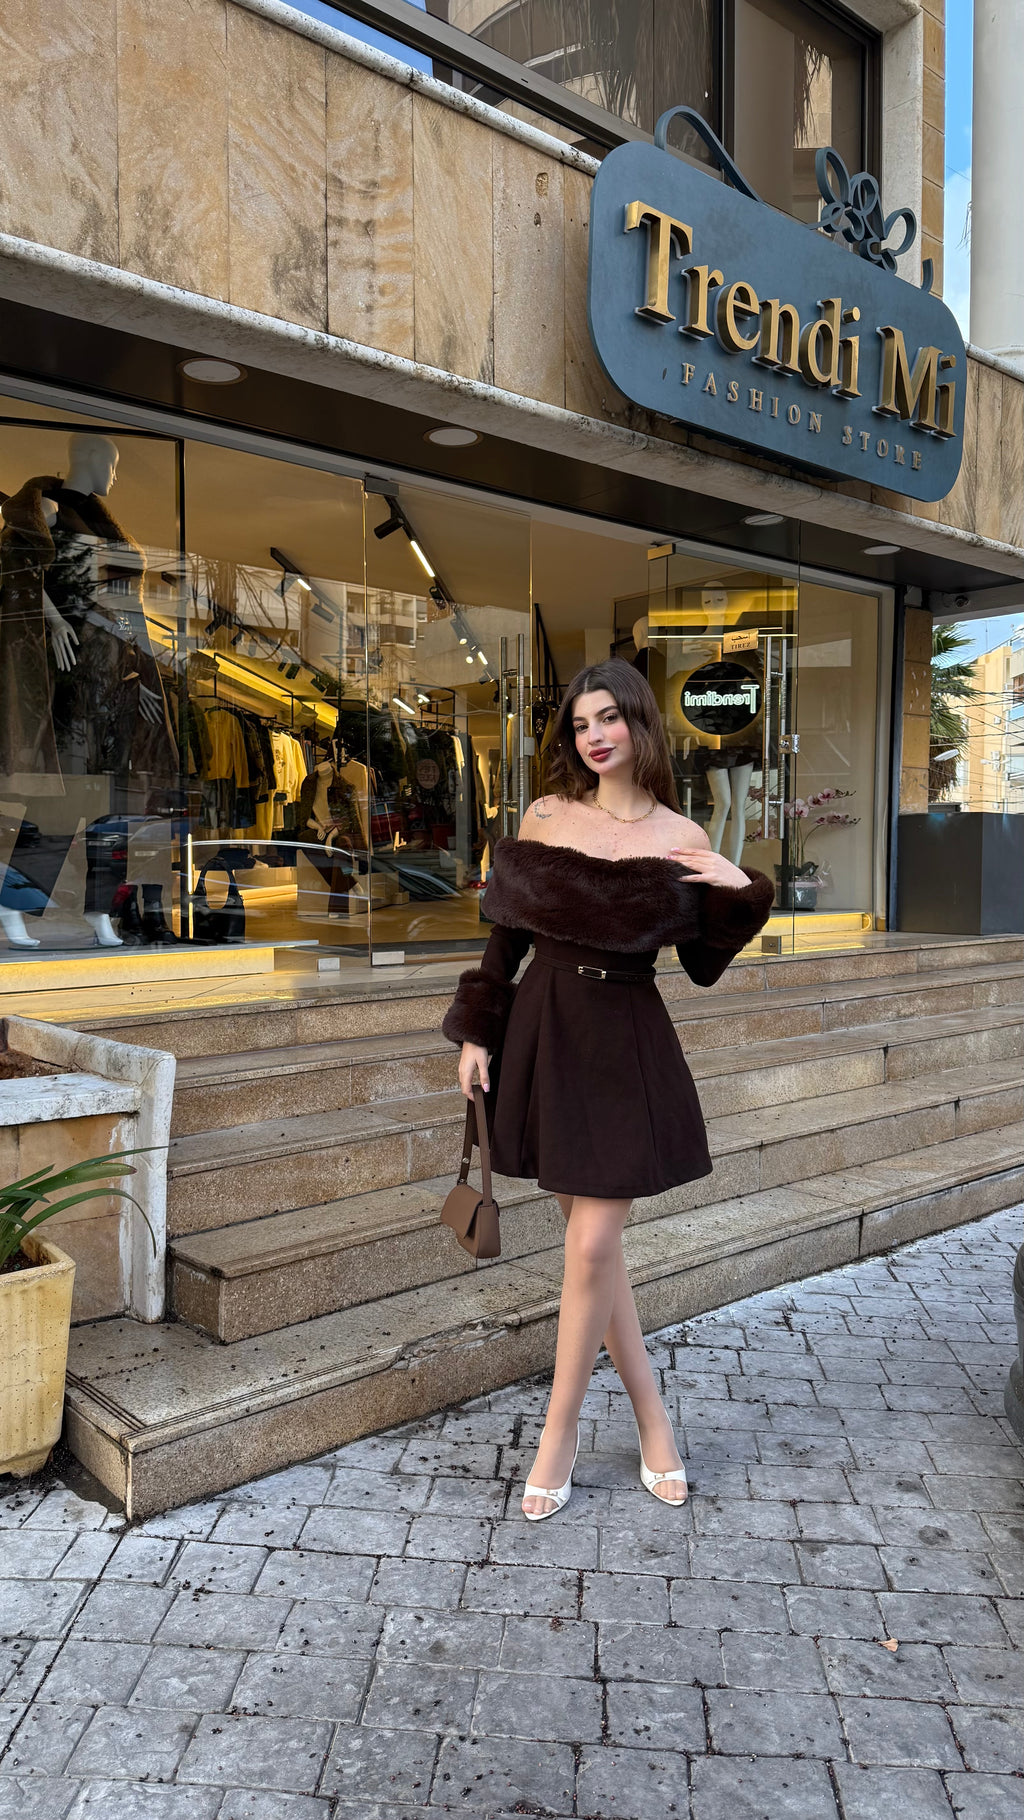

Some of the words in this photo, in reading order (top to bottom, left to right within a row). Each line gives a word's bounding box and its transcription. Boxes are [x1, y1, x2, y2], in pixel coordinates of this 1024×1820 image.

[624, 199, 863, 400] Trendi
[872, 325, 957, 440] Mi
[681, 362, 823, 434] FASHION
[842, 425, 922, 470] STORE
